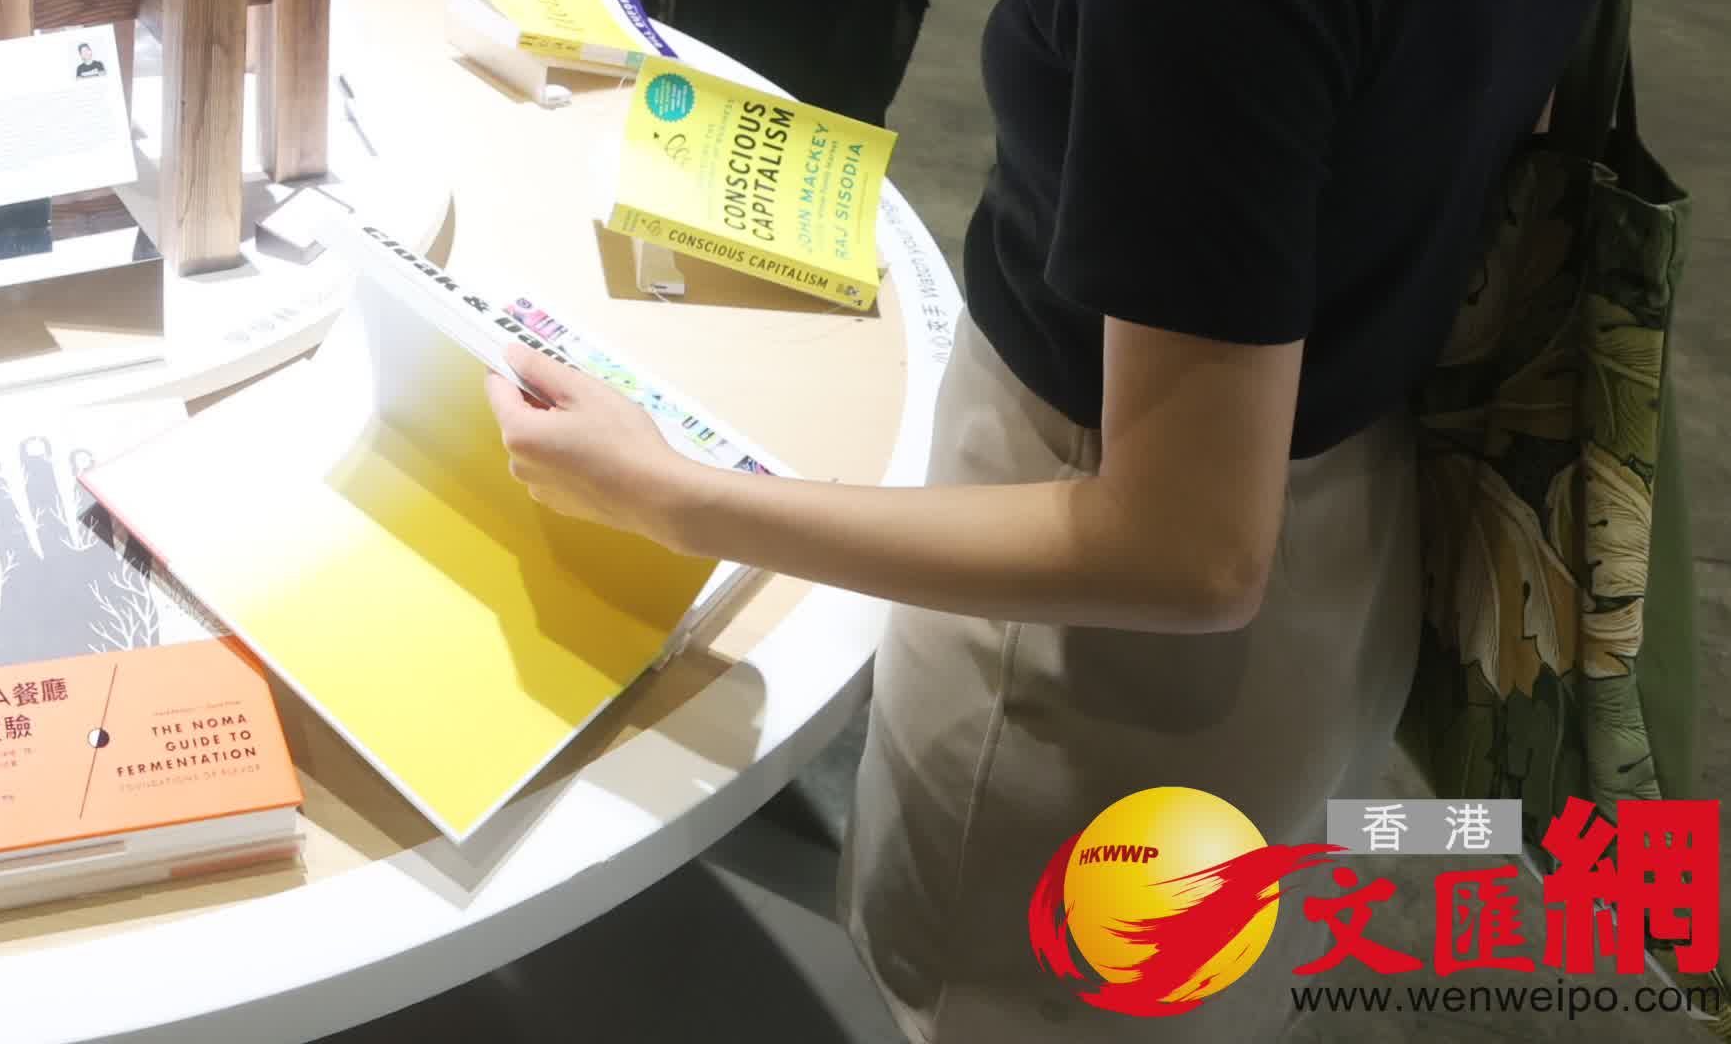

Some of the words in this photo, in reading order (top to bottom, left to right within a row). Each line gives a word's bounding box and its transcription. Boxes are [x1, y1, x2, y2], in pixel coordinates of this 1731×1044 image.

[724, 100, 766, 231] CONSCIOUS
[752, 106, 795, 242] CAPITALISM
[800, 122, 830, 204] MACKEY
[836, 143, 864, 221] SISODIA
[668, 229, 746, 263] CONSCIOUS
[749, 255, 830, 290] CAPITALISM
[463, 295, 490, 314] &
[151, 722, 184, 738] THE
[192, 713, 247, 731] NOMA
[165, 734, 221, 752] GUIDE
[229, 729, 252, 743] TO
[117, 746, 257, 778] FERMENTATION
